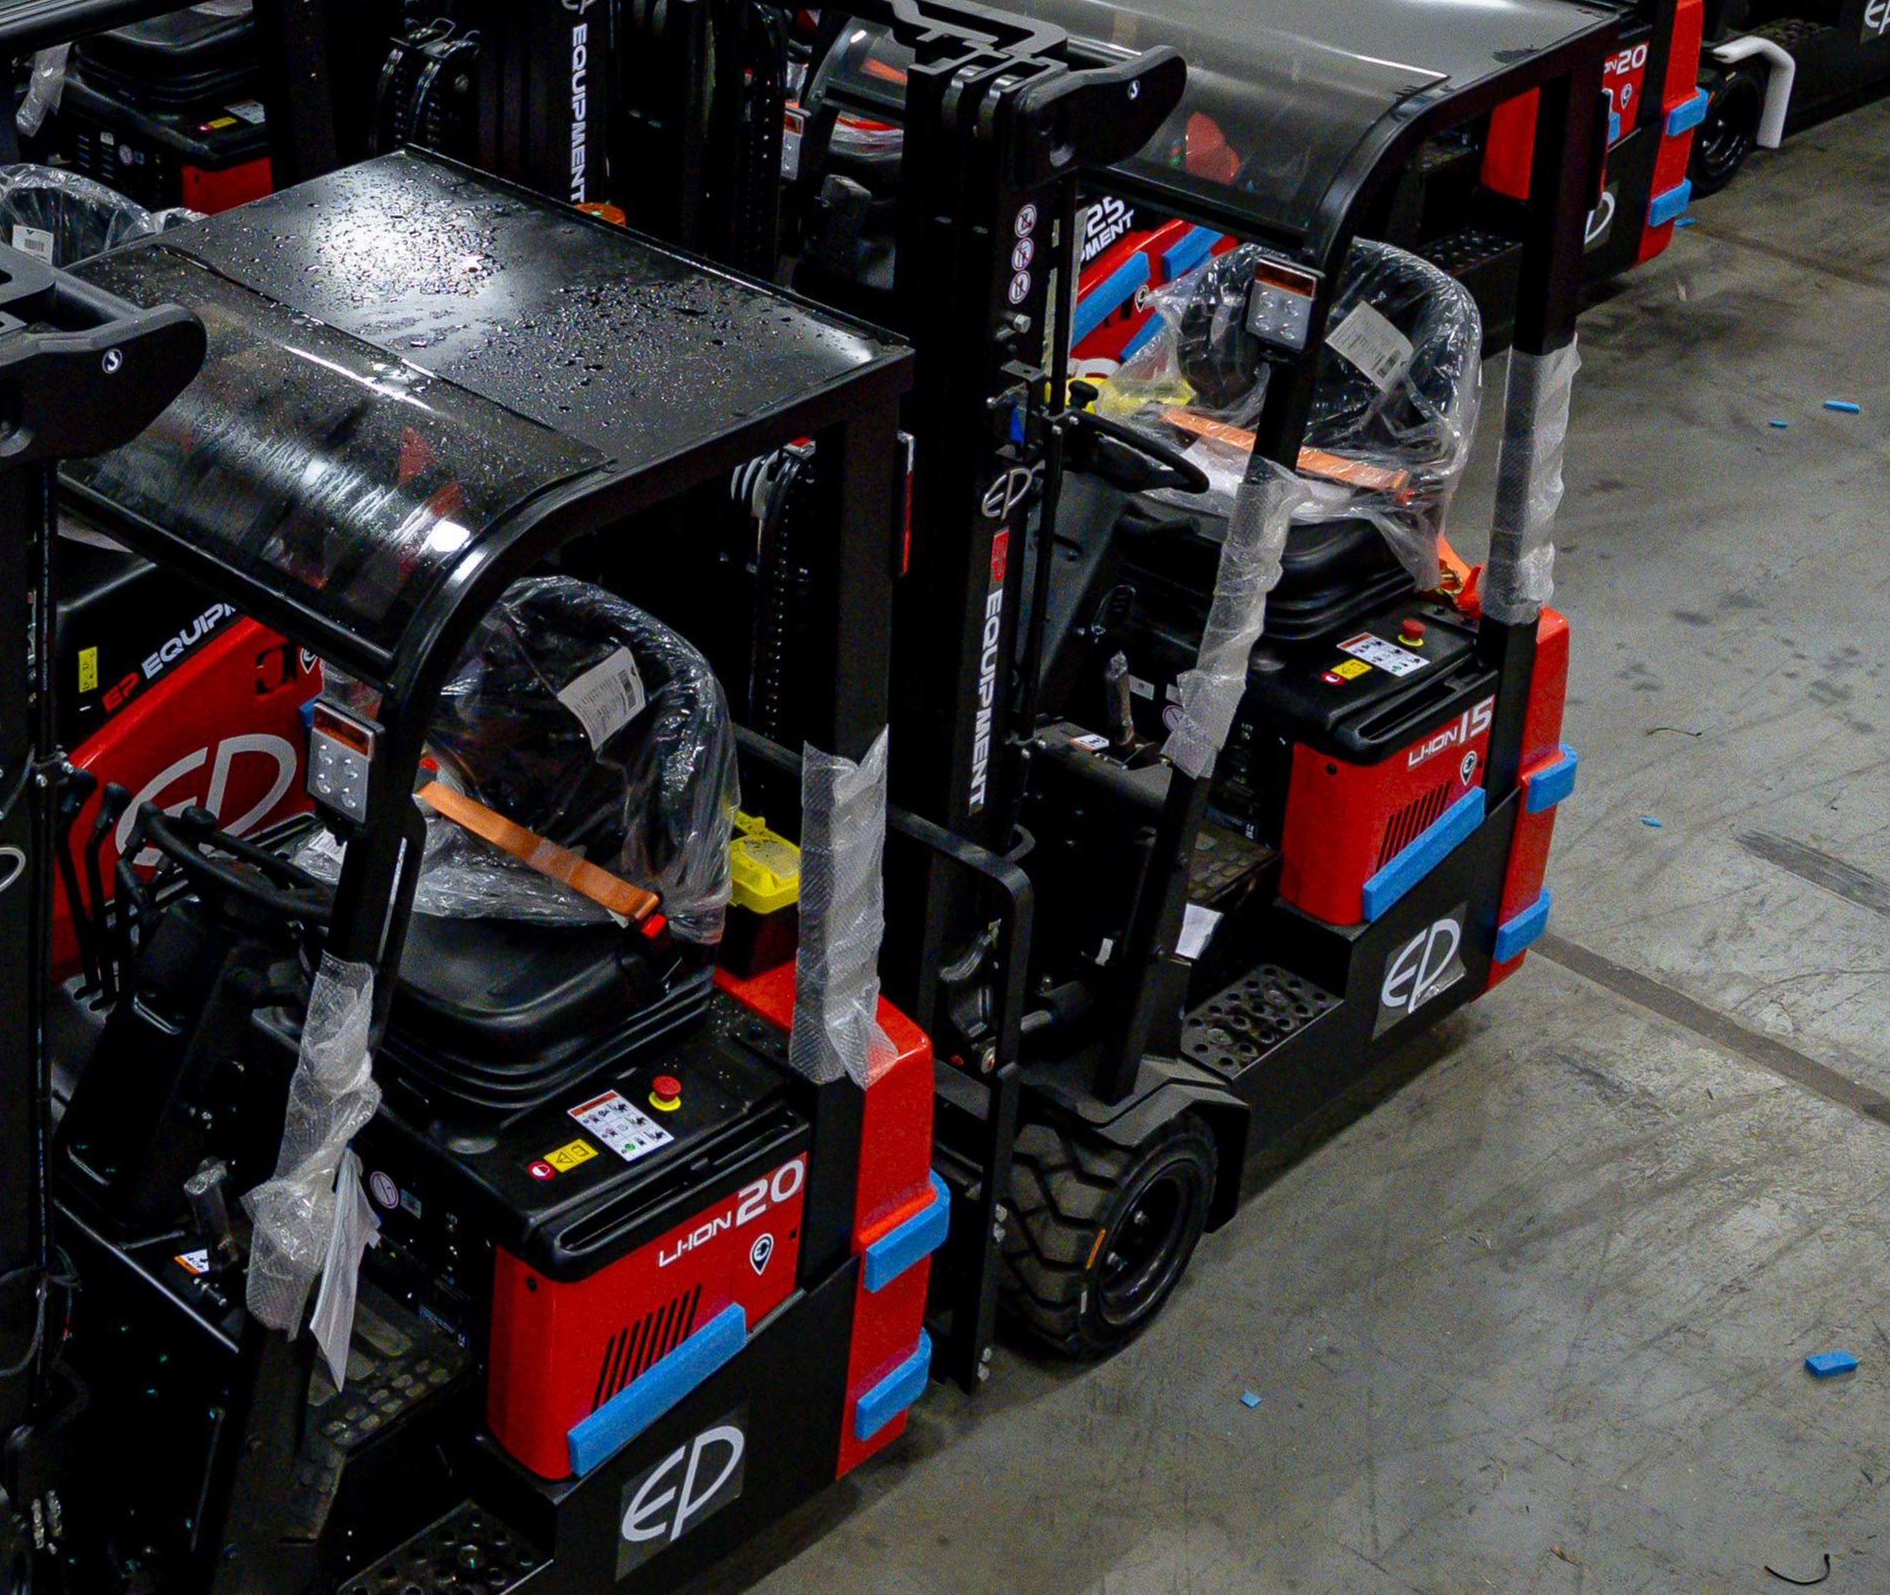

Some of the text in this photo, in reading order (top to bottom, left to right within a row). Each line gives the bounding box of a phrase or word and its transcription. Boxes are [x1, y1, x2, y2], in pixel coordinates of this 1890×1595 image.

[1616, 43, 1649, 76] 20
[570, 22, 589, 204] EQUIPMENT
[1086, 196, 1127, 238] 25
[981, 467, 1034, 521] EP
[102, 670, 141, 715] EP
[967, 587, 1003, 810] EQUIPMENT
[1458, 699, 1495, 747] 15
[1380, 917, 1463, 1015] EP
[734, 1158, 806, 1229] 20
[620, 1424, 746, 1543] EP
